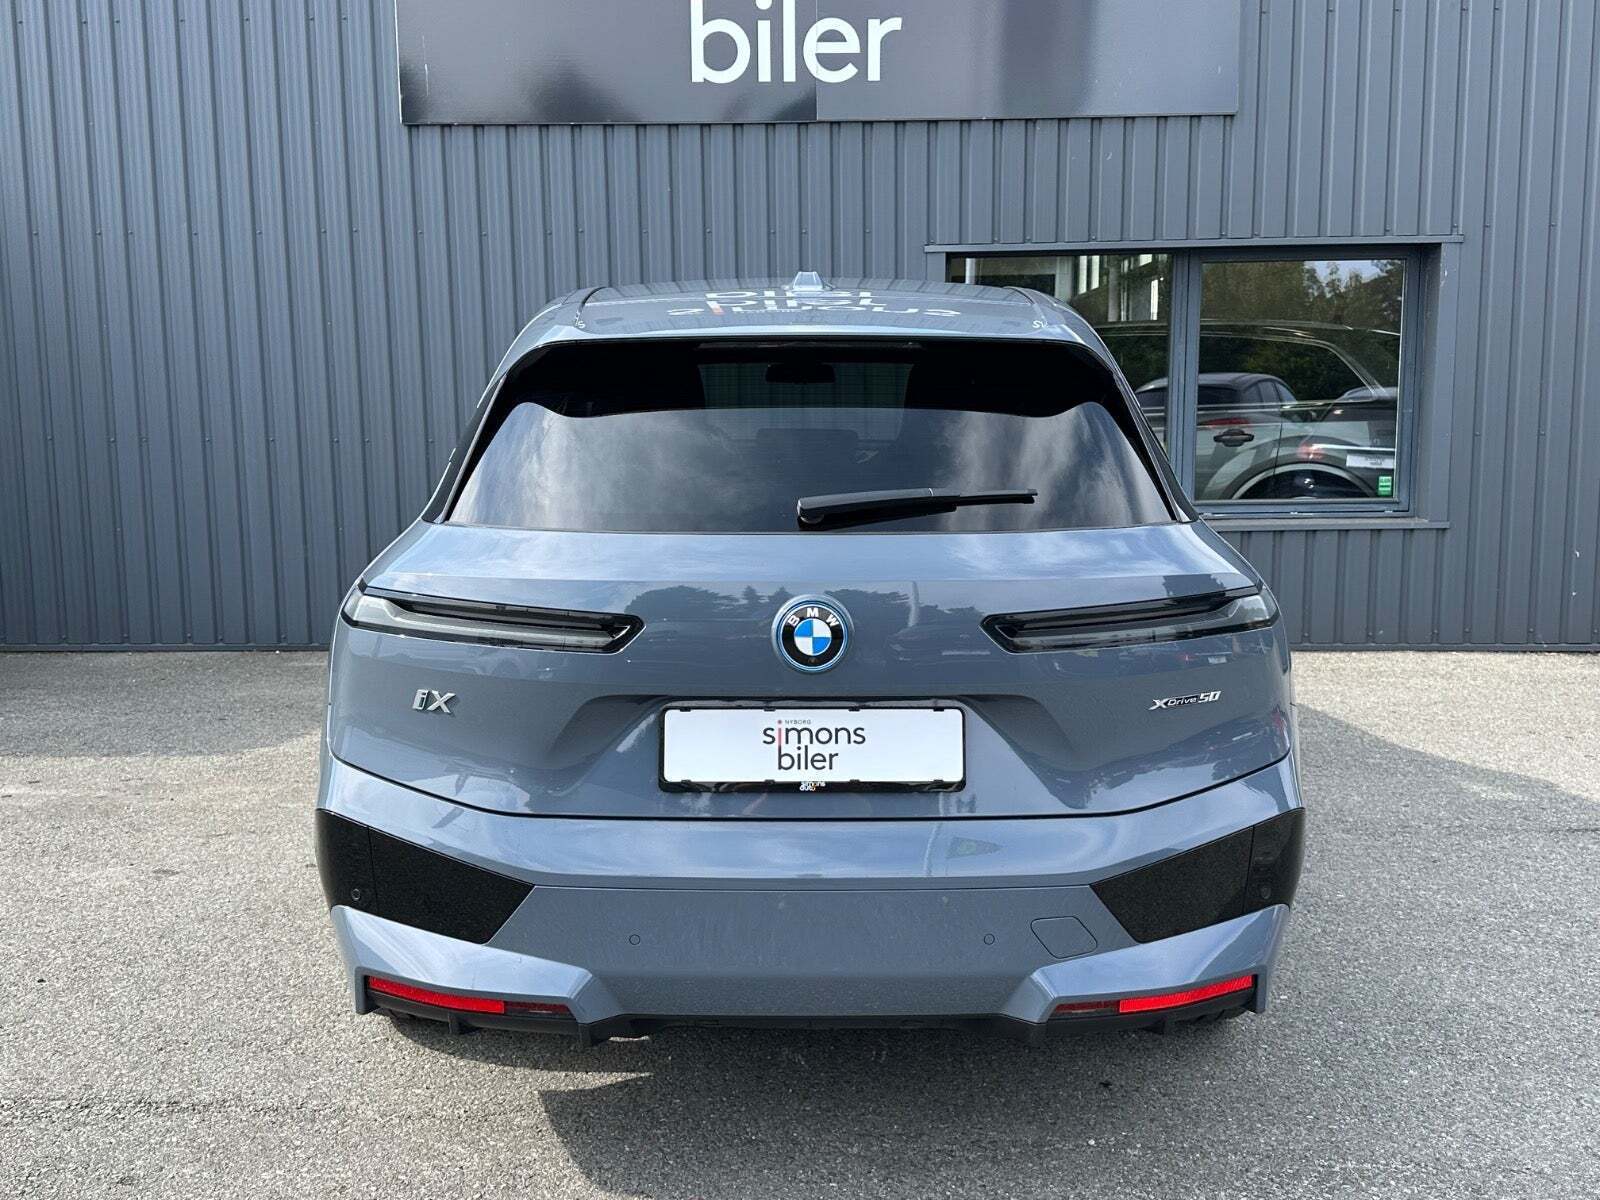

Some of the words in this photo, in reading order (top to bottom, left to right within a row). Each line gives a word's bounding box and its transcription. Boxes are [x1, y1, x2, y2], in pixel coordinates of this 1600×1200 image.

[690, 0, 903, 84] biler
[787, 607, 840, 627] BMW
[412, 689, 456, 713] iX
[762, 719, 866, 745] simons
[777, 745, 839, 770] biler
